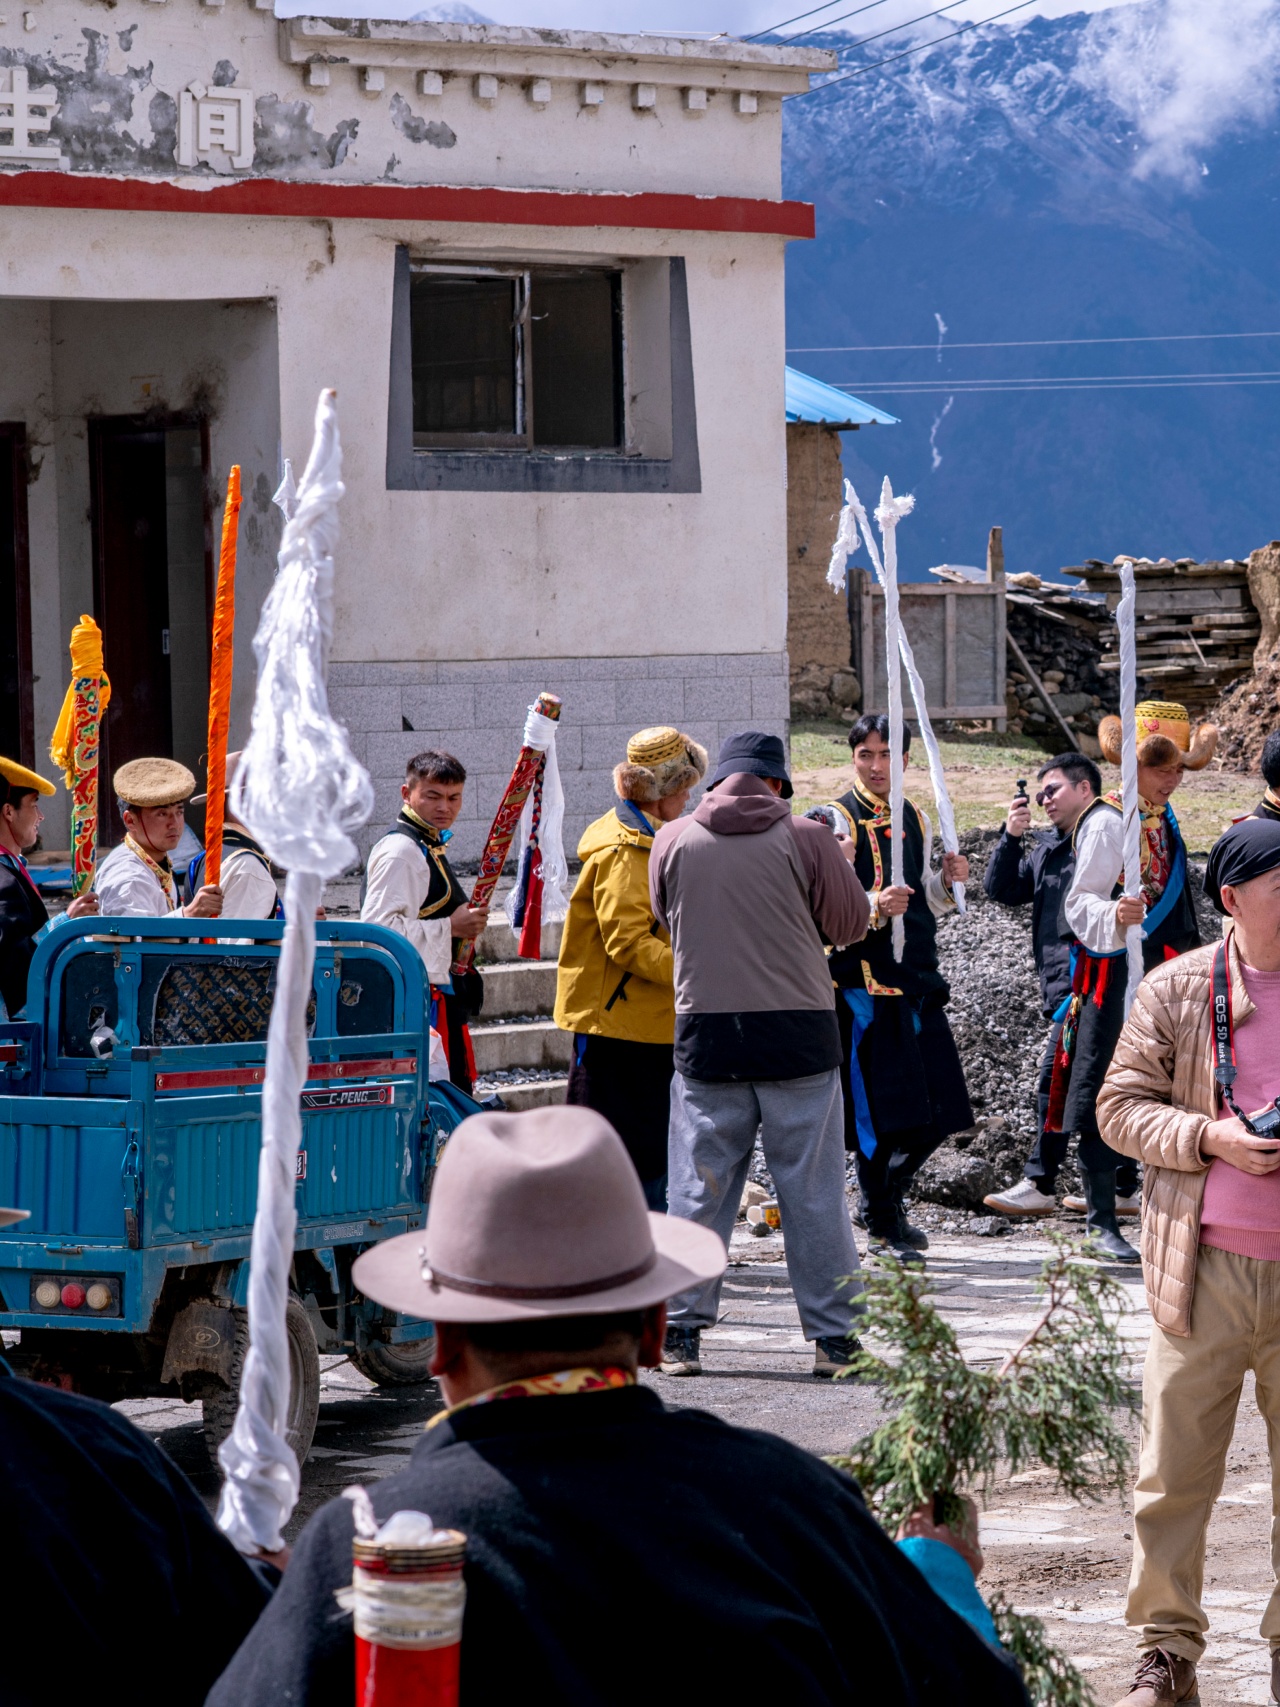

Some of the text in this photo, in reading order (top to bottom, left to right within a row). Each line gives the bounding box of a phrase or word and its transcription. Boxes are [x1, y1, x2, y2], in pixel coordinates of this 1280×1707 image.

[1215, 995, 1227, 1023] EOS
[1217, 1026, 1228, 1040] 5D
[1218, 1042, 1226, 1059] Mark
[329, 1091, 369, 1105] C-PENG
